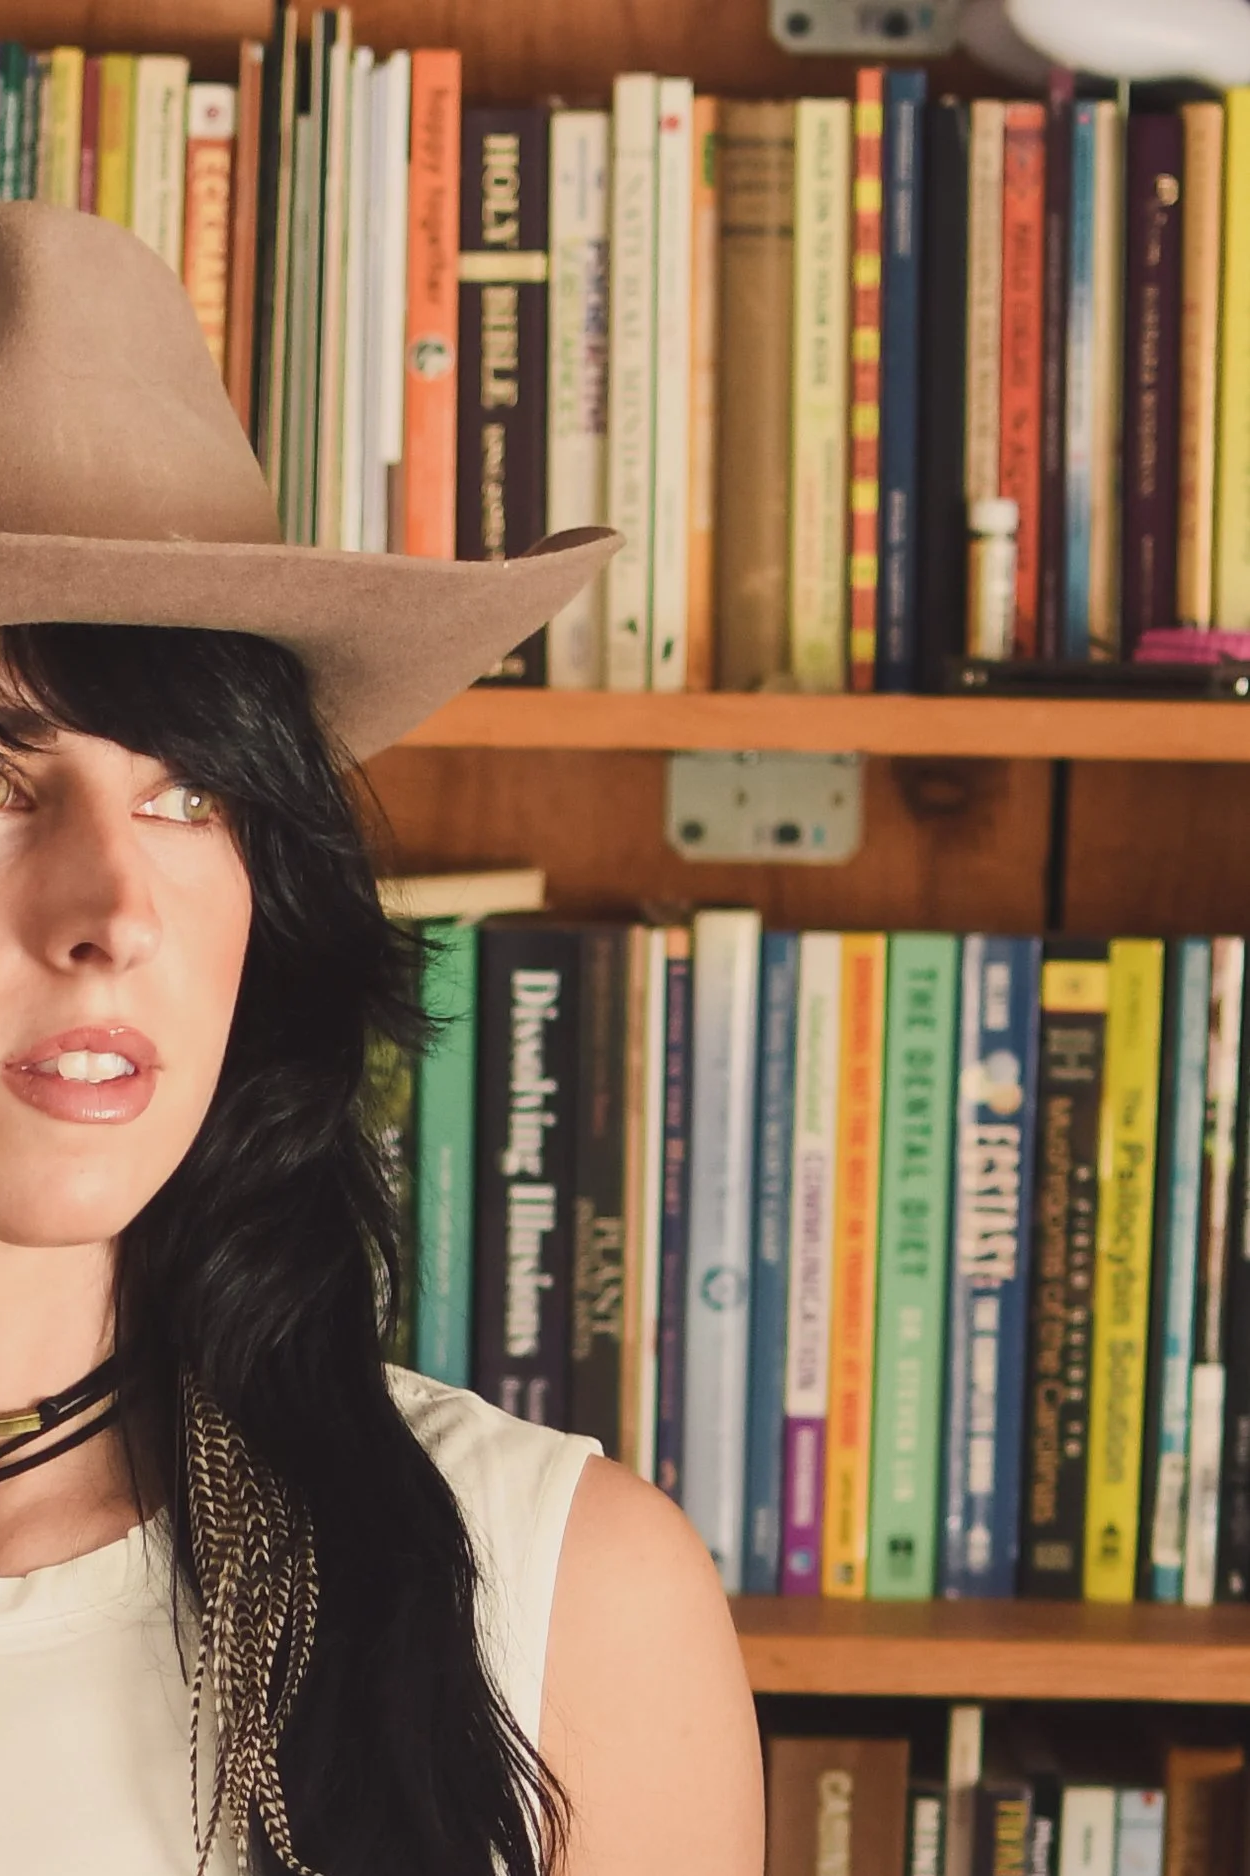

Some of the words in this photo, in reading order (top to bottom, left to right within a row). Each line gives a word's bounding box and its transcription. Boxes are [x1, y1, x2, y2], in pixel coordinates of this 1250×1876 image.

[422, 87, 453, 173] happy
[481, 134, 519, 247] HOLY
[421, 186, 452, 306] together
[480, 286, 519, 409] BIBLE
[905, 967, 938, 1032] THE
[499, 969, 561, 1176] Dissolving
[899, 1047, 936, 1181] DENTAL
[895, 1199, 929, 1279] DIET
[1037, 1095, 1078, 1277] Mushrooms
[1103, 1139, 1152, 1326] Psilocybin
[503, 1183, 556, 1358] Illusions
[591, 1215, 624, 1341] PLANT
[794, 1147, 832, 1393] COMMUNICATION
[1034, 1282, 1074, 1313] of
[1035, 1317, 1067, 1371] the
[1029, 1379, 1066, 1524] Carolinas
[1101, 1338, 1144, 1487] Solution
